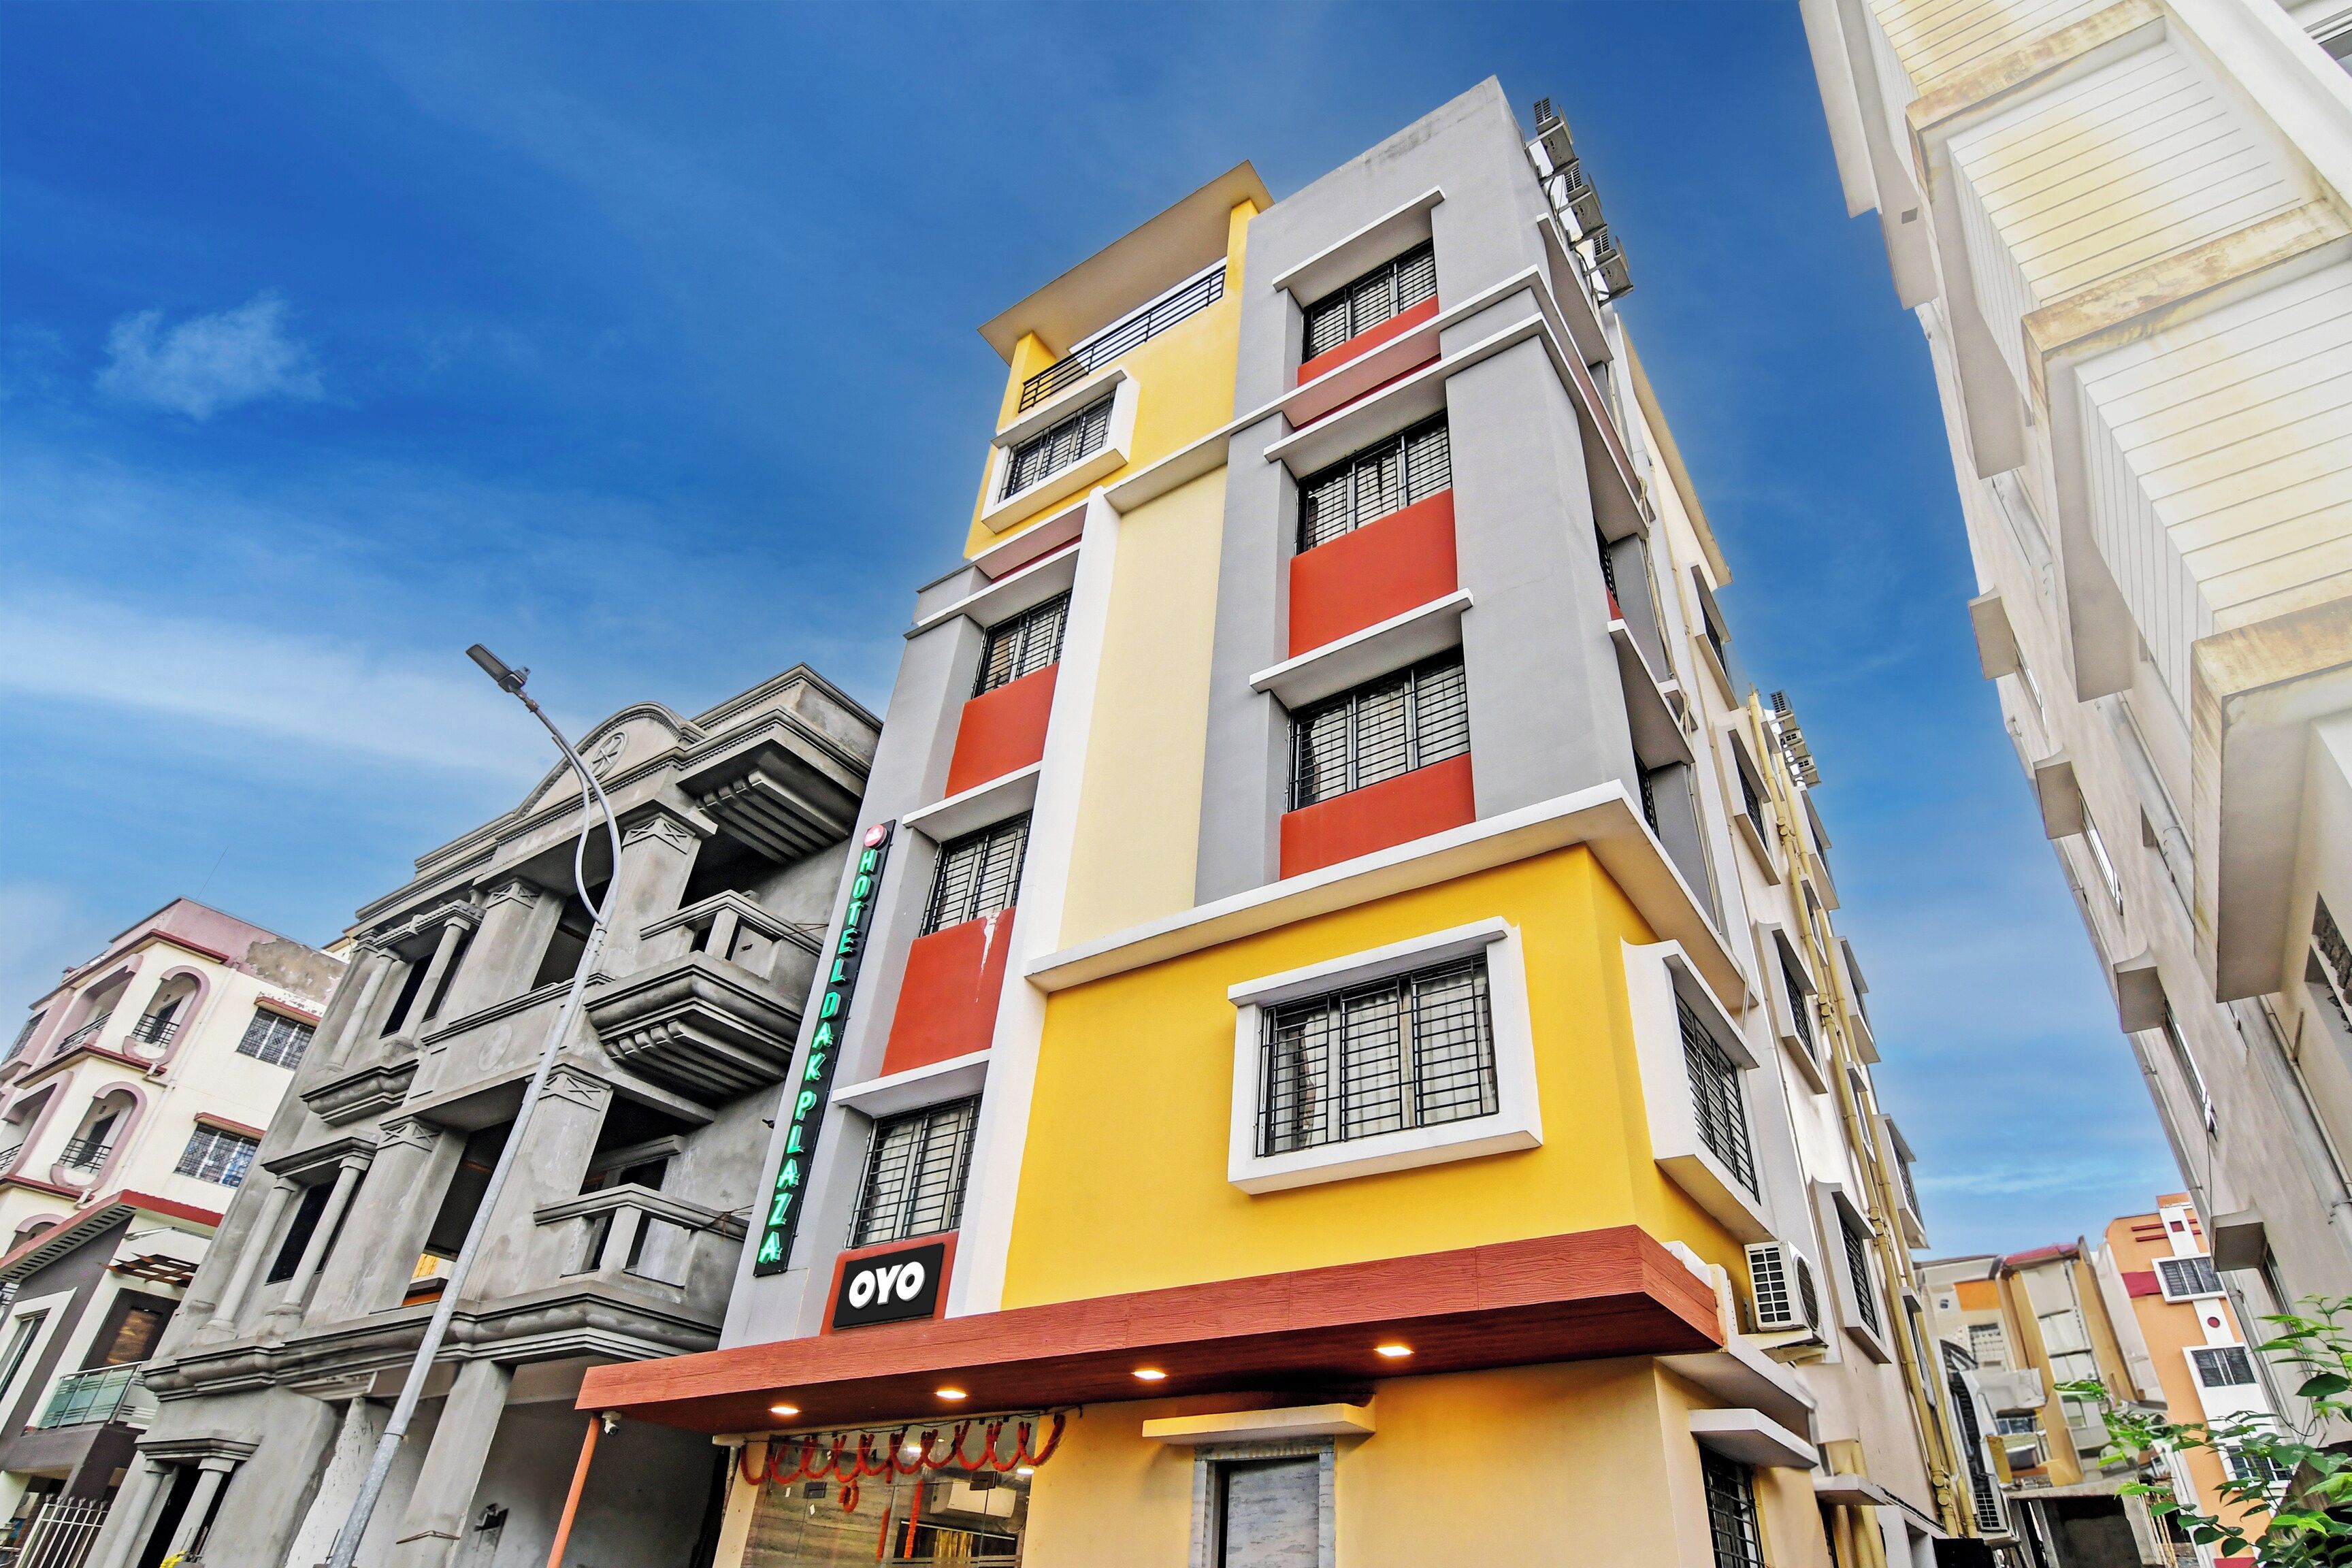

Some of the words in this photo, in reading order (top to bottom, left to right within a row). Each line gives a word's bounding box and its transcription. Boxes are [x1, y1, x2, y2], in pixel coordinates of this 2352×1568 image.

[830, 849, 878, 983] HOTEL
[804, 992, 841, 1082] DAK
[757, 1090, 817, 1264] PLAZA
[849, 1261, 926, 1309] OYO
